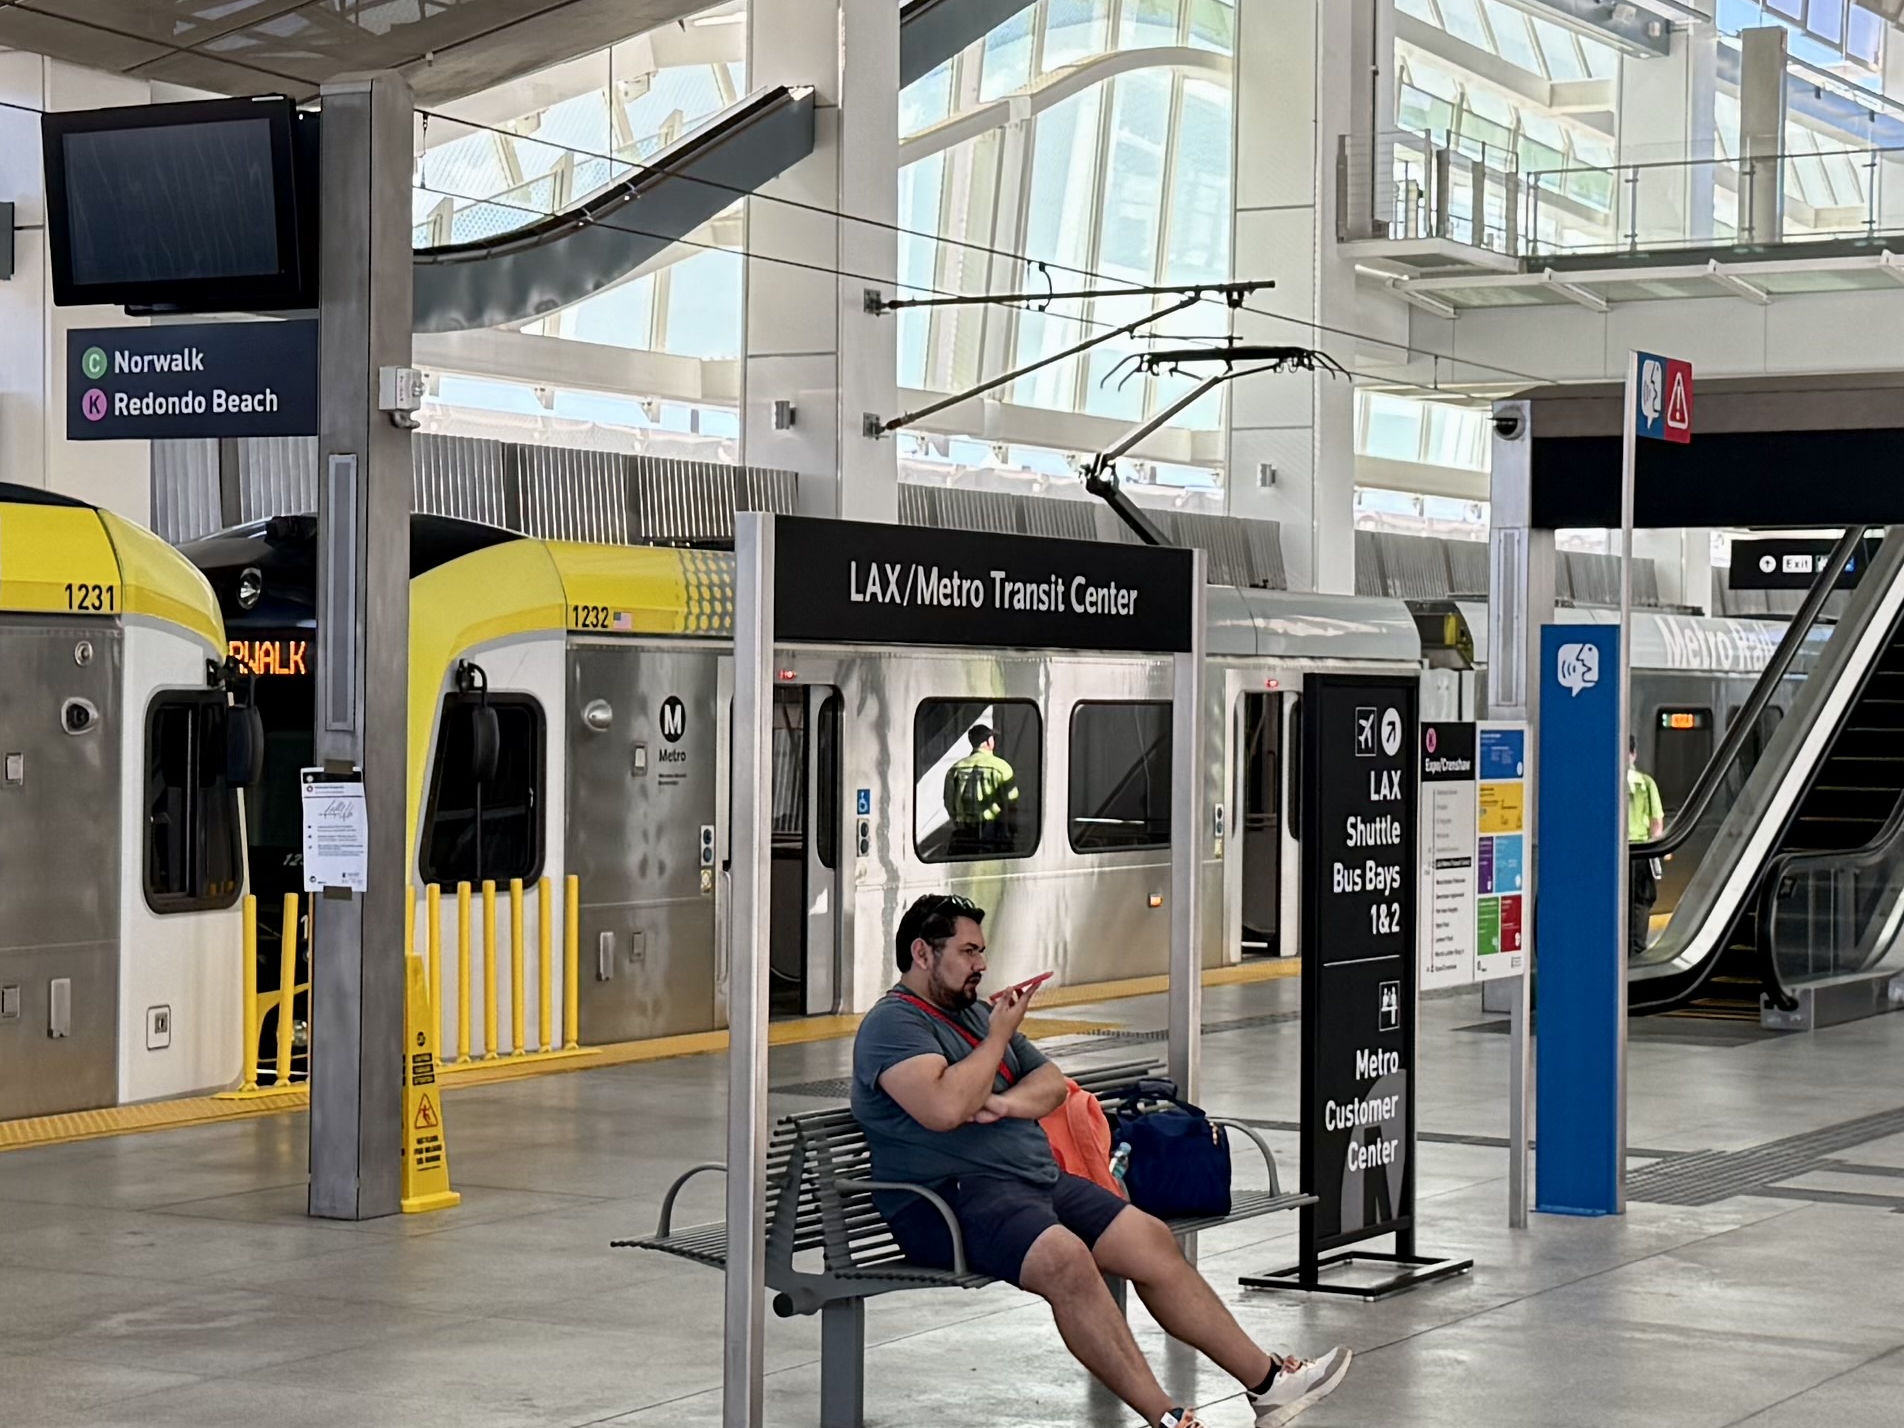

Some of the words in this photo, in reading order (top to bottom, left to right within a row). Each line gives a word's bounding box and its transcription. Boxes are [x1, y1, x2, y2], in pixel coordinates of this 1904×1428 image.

[114, 347, 204, 374] Norwalk
[114, 390, 206, 416] Redondo
[212, 387, 278, 413] Beach
[1785, 558, 1809, 569] Exit
[65, 583, 114, 611] 1231
[850, 560, 984, 608] LAX/Metro
[990, 570, 1065, 612] Transit
[1070, 575, 1138, 616] Center
[572, 605, 609, 629] 1232
[1654, 615, 1733, 670] Metro
[659, 749, 687, 762] Metro
[1425, 757, 1471, 775] Expo/Crenshaw
[1370, 770, 1402, 801] LAX
[1346, 814, 1401, 847] Shuttle
[1333, 861, 1362, 894] Bus
[1365, 859, 1401, 896] Bays
[1370, 902, 1401, 935] 1&2
[1355, 1047, 1399, 1081] Metro
[1325, 1095, 1399, 1132] Customer
[1347, 1137, 1399, 1172] Center
